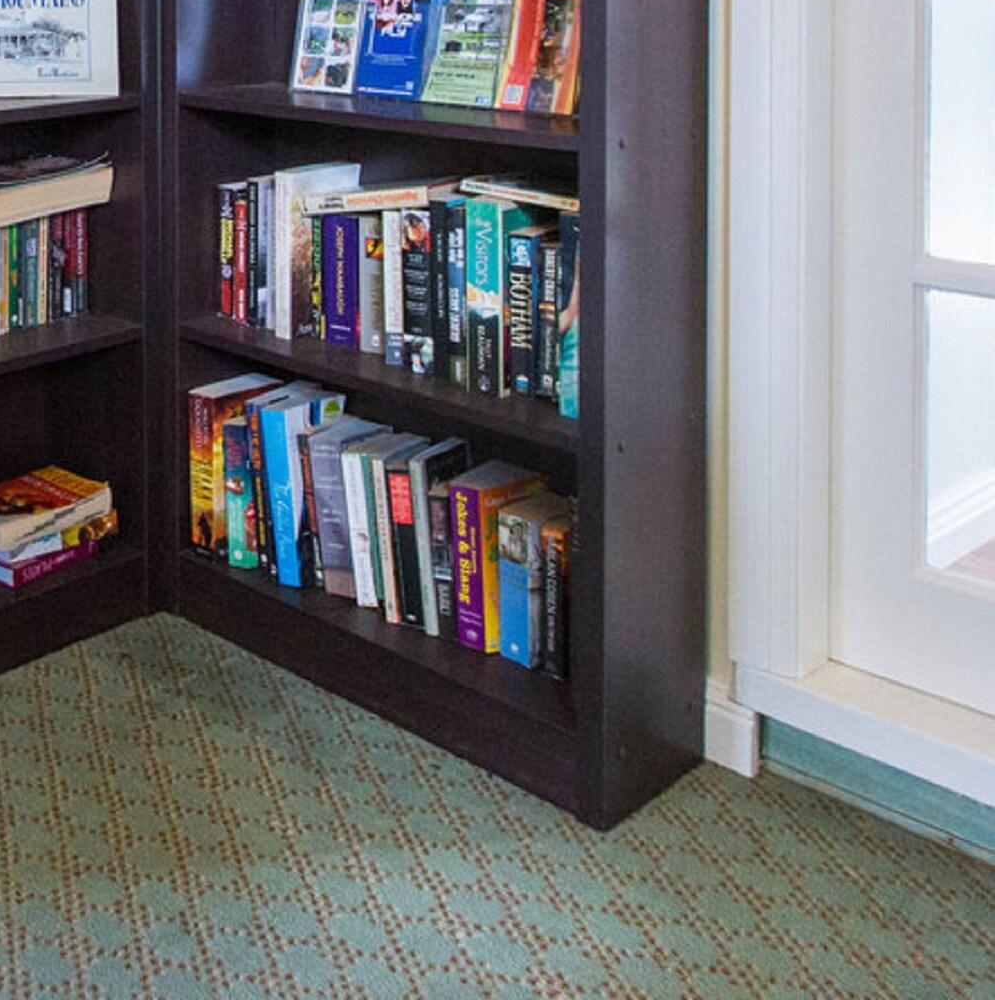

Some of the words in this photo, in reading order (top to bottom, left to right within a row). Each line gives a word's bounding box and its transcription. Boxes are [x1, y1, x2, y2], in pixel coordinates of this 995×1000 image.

[510, 271, 533, 349] BOTHAM
[455, 491, 470, 537] Jokes
[457, 540, 471, 554] &
[457, 557, 473, 605] Slang
